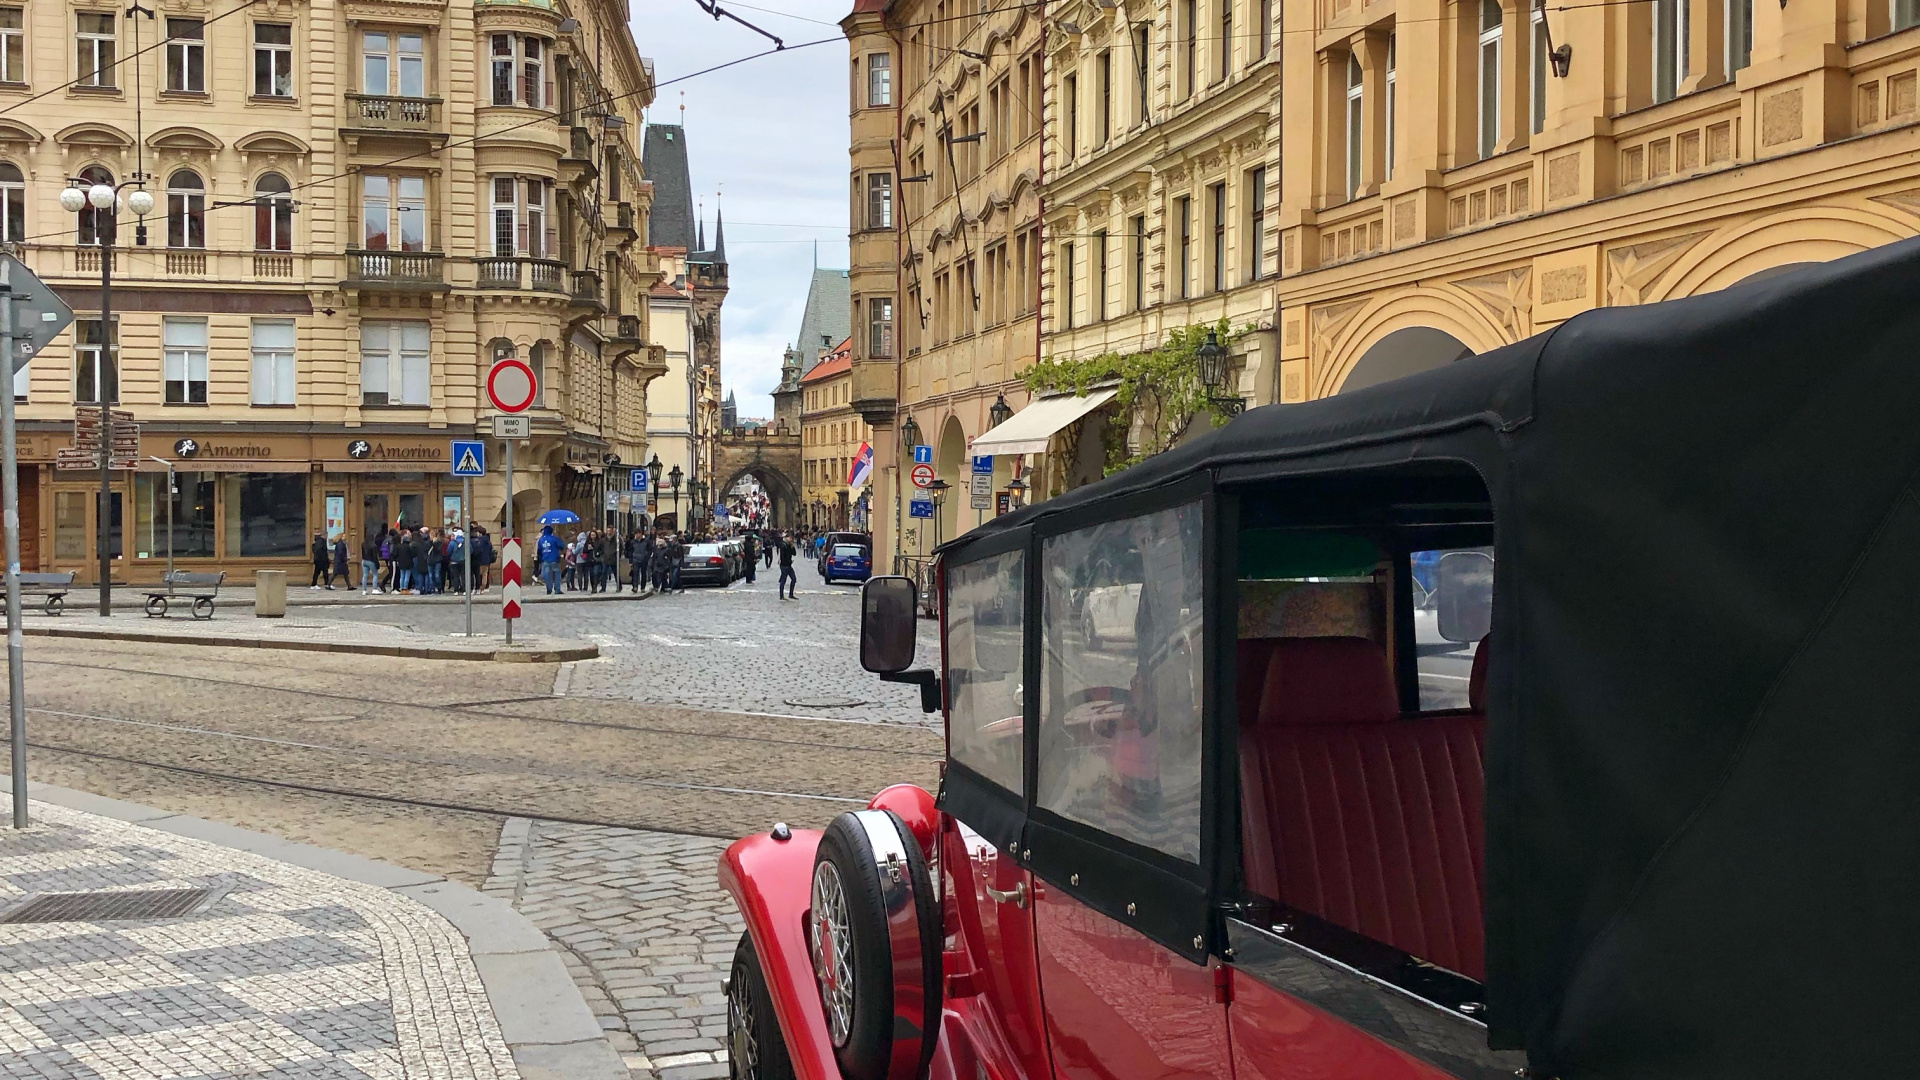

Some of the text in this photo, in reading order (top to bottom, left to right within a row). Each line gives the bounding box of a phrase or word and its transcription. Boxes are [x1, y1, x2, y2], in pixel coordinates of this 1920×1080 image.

[200, 441, 271, 457] Amorino
[371, 442, 441, 458] Amorino
[634, 472, 645, 486] P
